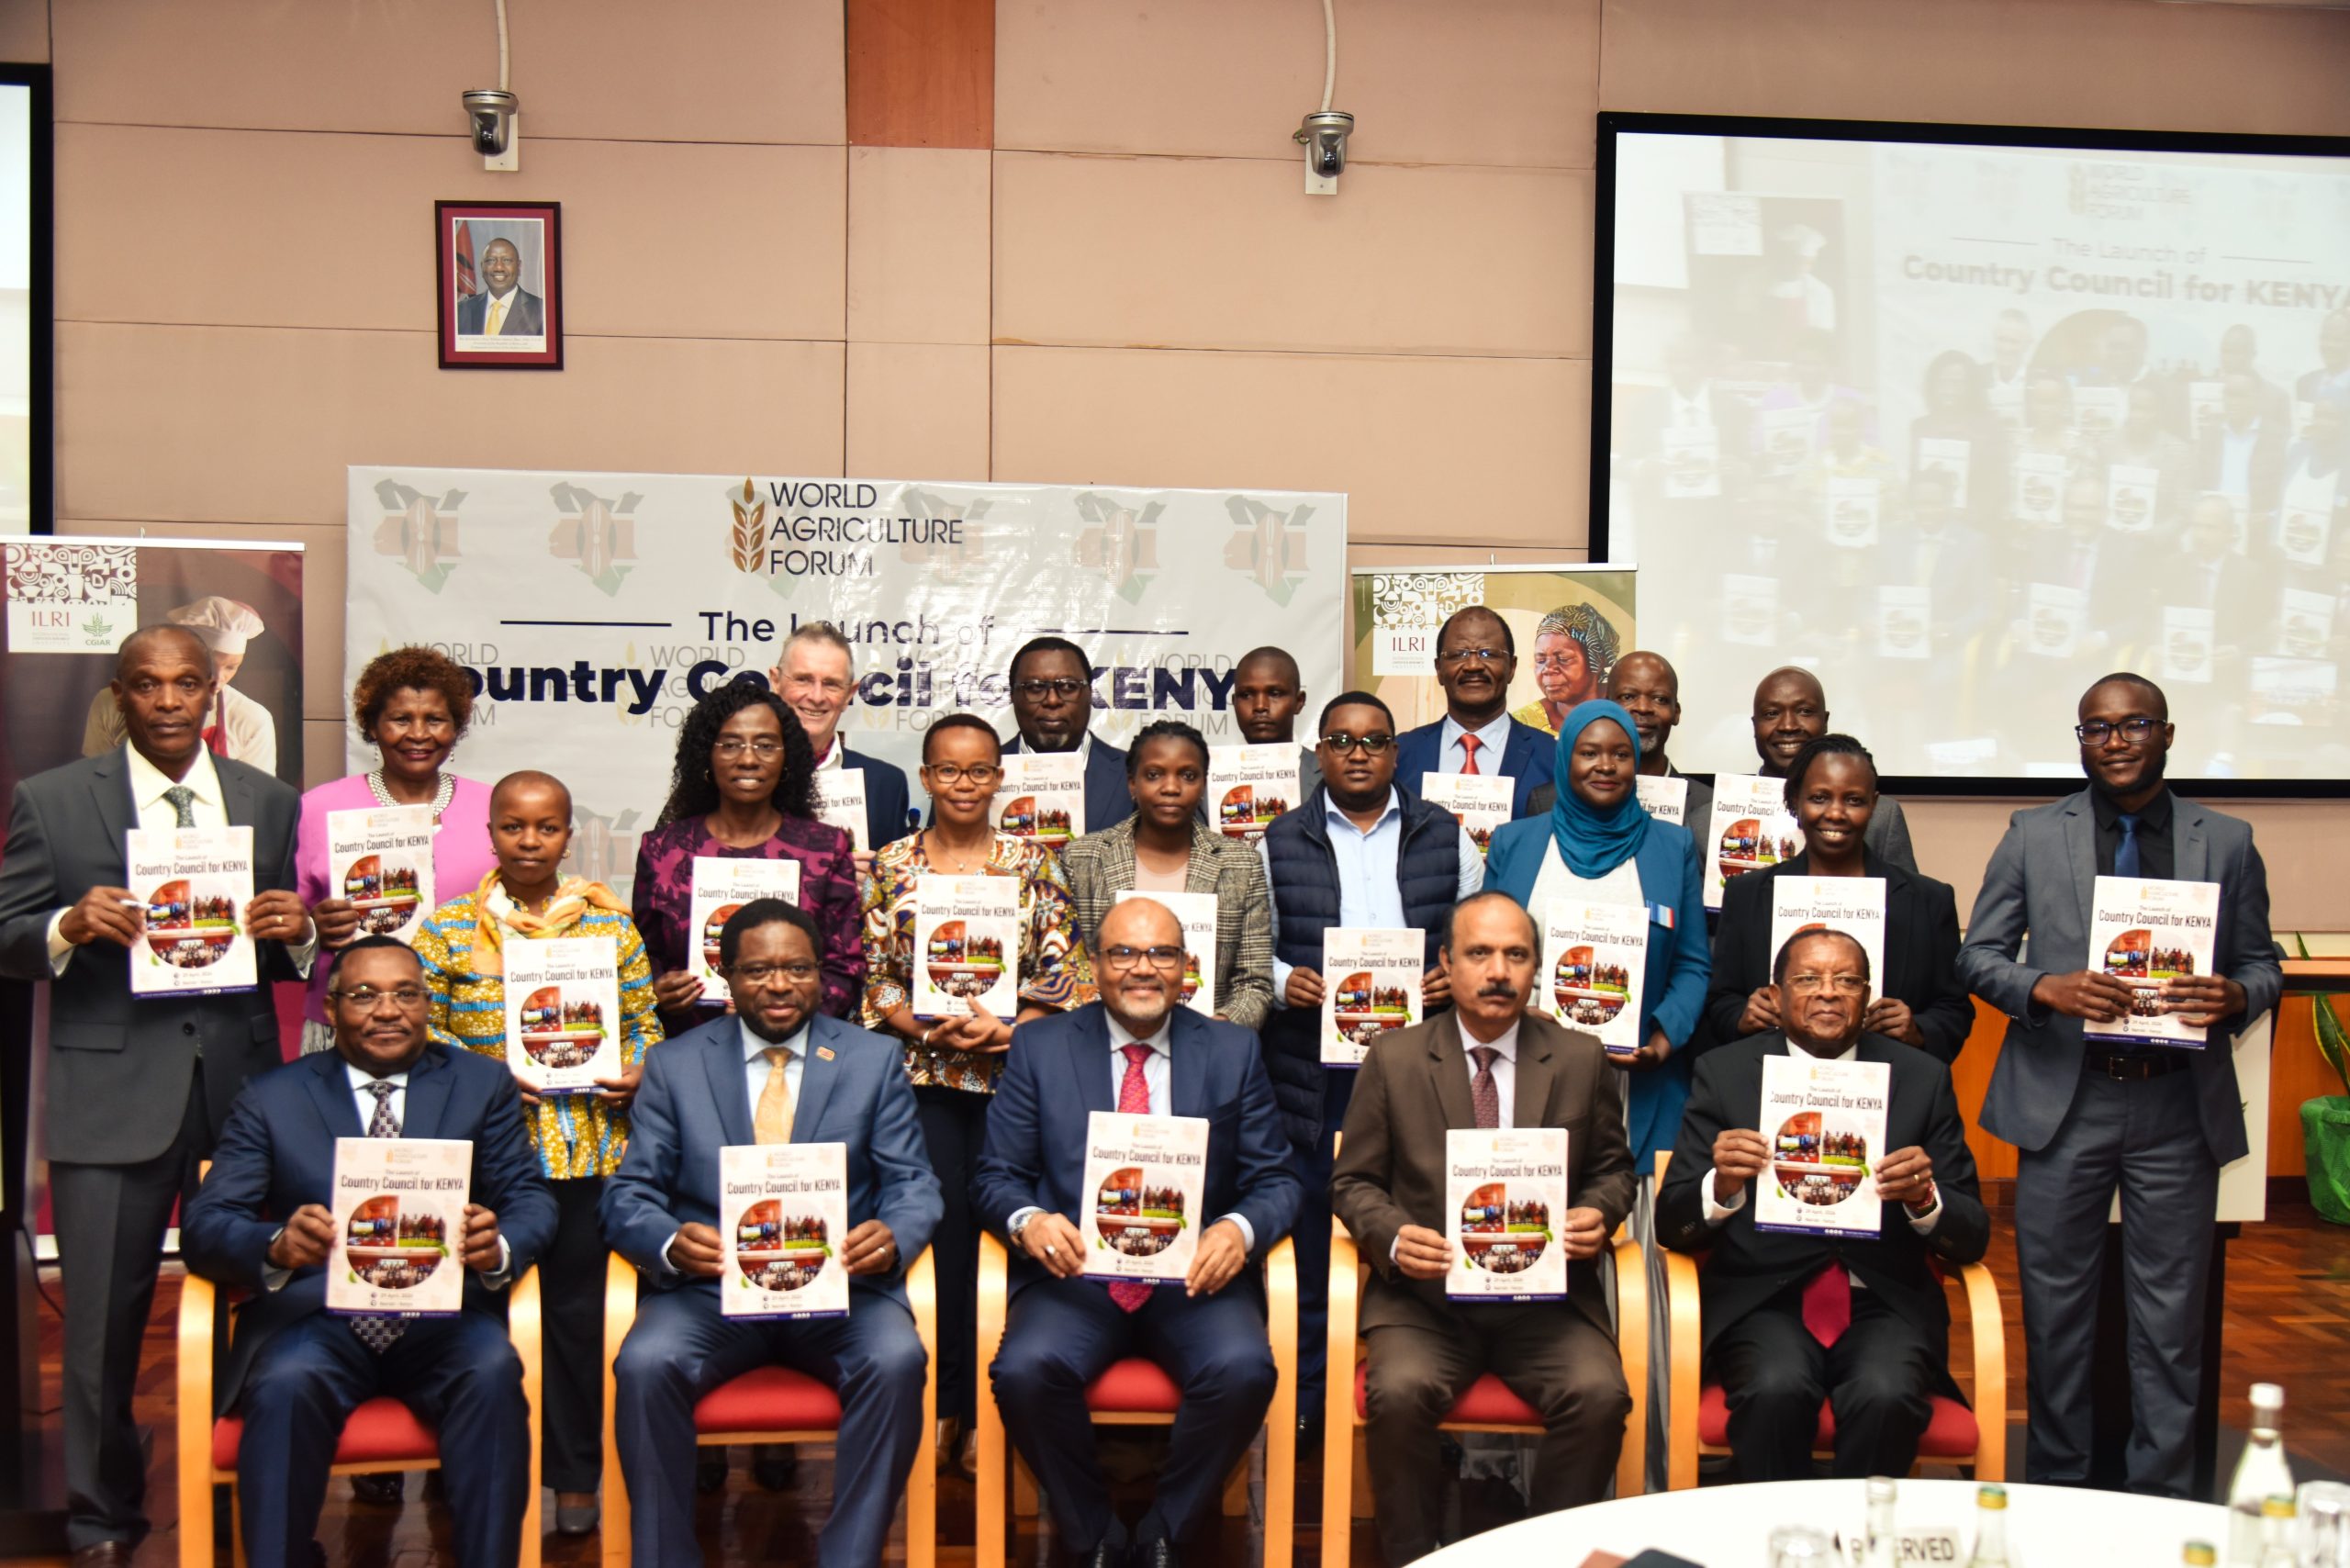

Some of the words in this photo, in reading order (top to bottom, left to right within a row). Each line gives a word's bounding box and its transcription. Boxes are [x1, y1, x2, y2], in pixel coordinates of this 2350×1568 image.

[2052, 238, 2092, 258] The
[2099, 244, 2178, 264] Launch
[2186, 247, 2208, 265] of
[1904, 254, 2036, 295] Country
[2047, 264, 2173, 299] Council
[2185, 274, 2235, 303] for
[770, 482, 878, 509] WORLD
[769, 516, 963, 544] AGRICULTURE
[770, 550, 873, 576] FORUM
[32, 610, 70, 627] ILRI
[699, 610, 775, 642] The
[790, 612, 939, 644] Lunch
[957, 614, 995, 644] of
[404, 642, 498, 665] ORLD
[1393, 636, 1425, 652] ILRI
[458, 660, 667, 715] untry
[687, 659, 932, 708] Cocil
[950, 661, 1013, 708] fo
[1091, 666, 1237, 711] KENY
[335, 843, 364, 853] Country
[367, 839, 394, 850] Council
[396, 837, 406, 847] for
[408, 835, 429, 846] KENYA
[136, 864, 171, 878] Country
[174, 861, 206, 874] Council
[209, 861, 220, 872] for
[222, 860, 248, 872] KENYA
[2099, 910, 2134, 924] Country
[2136, 913, 2169, 925] Council
[2171, 914, 2183, 926] for
[2185, 915, 2211, 928] KENYA
[510, 971, 543, 983] Country
[545, 970, 575, 981] Council
[577, 969, 588, 980] for
[590, 969, 614, 979] KENYA
[1807, 1093, 1840, 1107] Council
[1841, 1096, 1854, 1108] for
[1856, 1098, 1883, 1110] KENYA
[341, 1175, 379, 1191] Country
[383, 1177, 418, 1189] Council
[420, 1179, 433, 1190] for
[436, 1178, 464, 1190] KENYA
[727, 1182, 763, 1195] Country
[766, 1180, 798, 1193] Council
[800, 1180, 812, 1192] for
[815, 1179, 841, 1192] KENYA
[1851, 1537, 1954, 1562] RRVED
